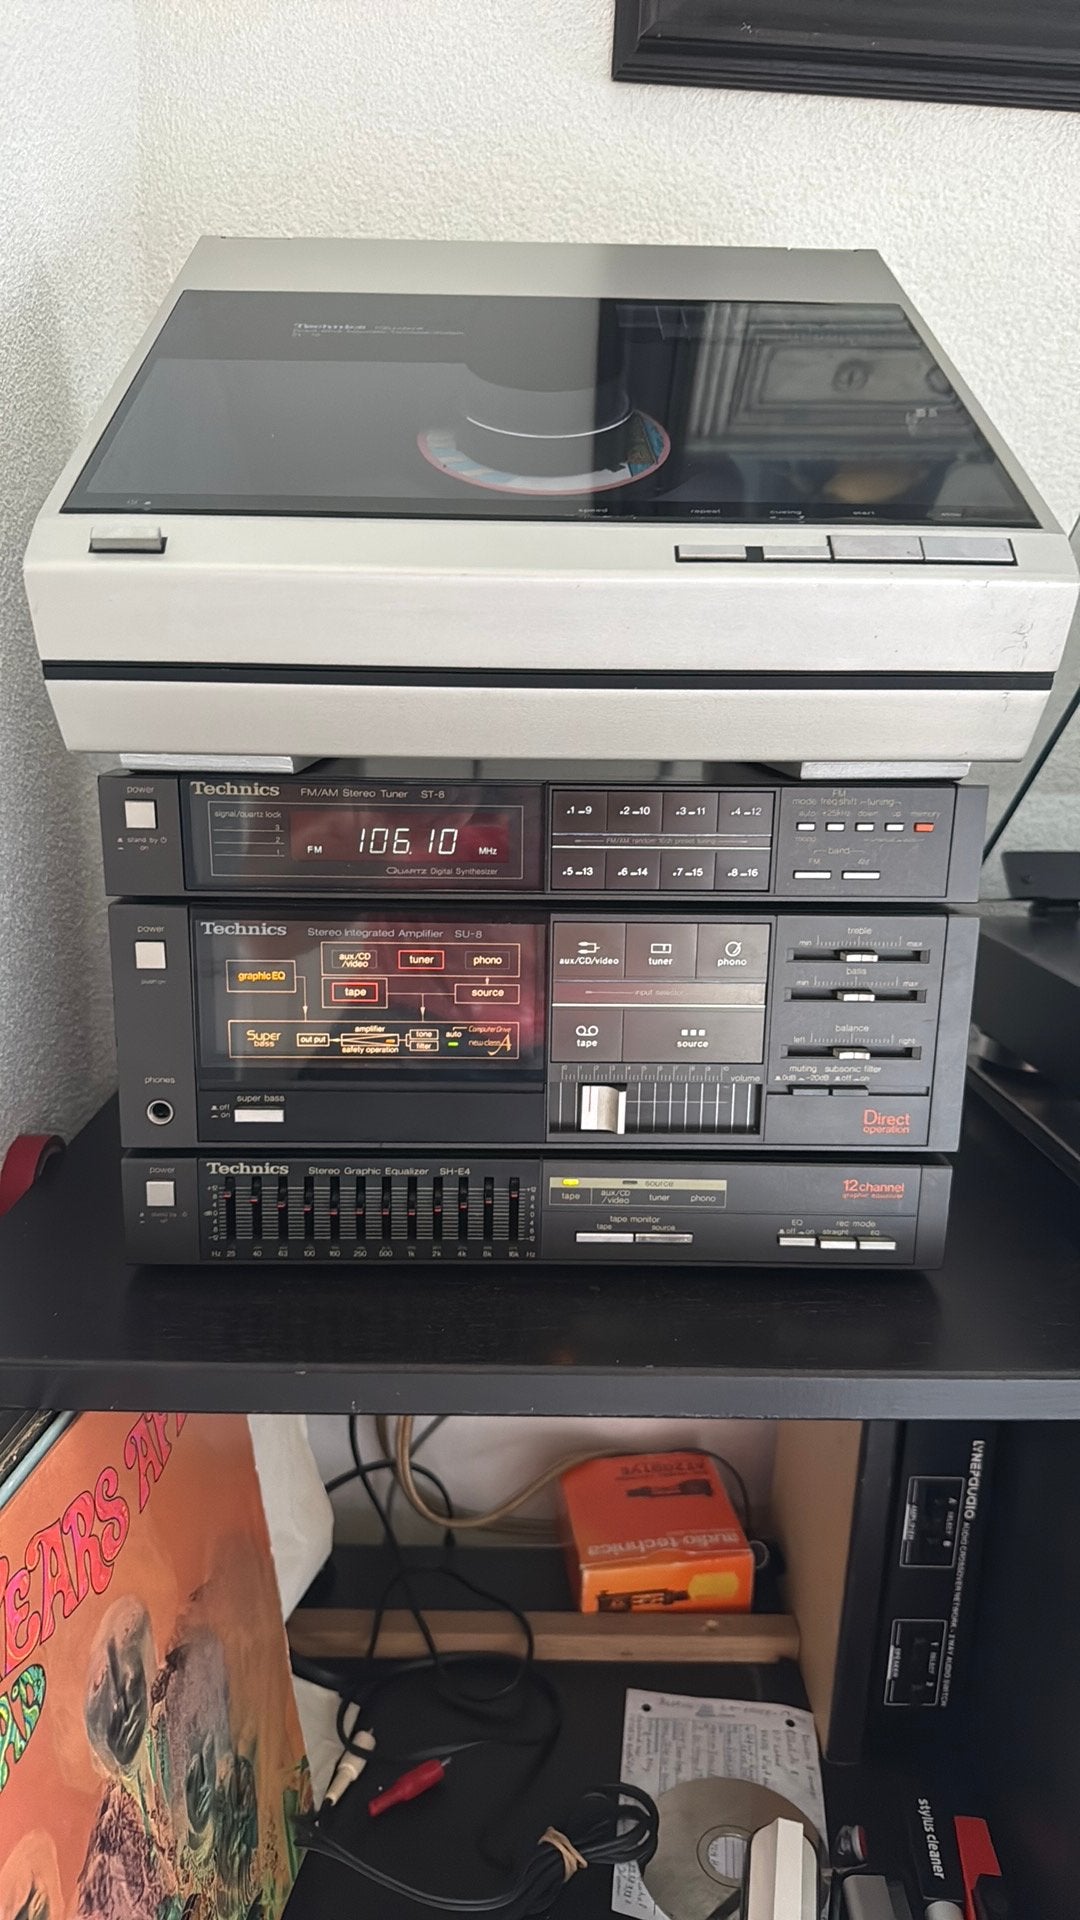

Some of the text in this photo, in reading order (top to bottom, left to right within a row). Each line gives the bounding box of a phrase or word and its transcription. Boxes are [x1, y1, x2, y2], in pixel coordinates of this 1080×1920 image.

[127, 786, 154, 794] power
[190, 781, 280, 796] Technics
[300, 787, 445, 799] FM/AM Stereo Tuner ST-8
[265, 810, 281, 818] lock
[307, 845, 323, 854] FM
[479, 847, 497, 856] MHz
[430, 867, 453, 876] Digital
[456, 867, 498, 876] Synthesizer
[137, 926, 165, 934] power
[201, 922, 287, 936] Technics
[307, 928, 483, 939] Stereo Integrated Amplifier SU-8
[848, 927, 872, 935] treble
[339, 952, 371, 961] aux/CD
[409, 955, 435, 965] tuner
[473, 955, 503, 966] phono
[341, 960, 369, 968] /video
[559, 957, 619, 966] aux/CD/video
[648, 957, 673, 966] tuner
[717, 958, 748, 967] phono
[846, 967, 867, 975] bass
[344, 987, 367, 998] tape
[471, 988, 505, 998] source
[355, 1025, 386, 1034] amplifier
[835, 1024, 869, 1032] balance
[246, 1029, 282, 1042] Super
[576, 1038, 598, 1048] tape
[677, 1039, 709, 1048] source
[899, 1037, 916, 1046] right
[342, 1046, 399, 1055] safety operation
[789, 1065, 817, 1074] muting
[824, 1065, 882, 1073] subsonic filter
[144, 1076, 175, 1085] phones
[236, 1094, 285, 1103] super bass
[863, 1109, 911, 1126] Direct
[863, 1125, 910, 1135] operation
[150, 1166, 175, 1175] power
[206, 1162, 289, 1175] Technics
[308, 1166, 471, 1176] Stereo Graphic Equalizer SH-E4
[645, 1180, 674, 1188] source
[859, 1182, 905, 1192] channel
[561, 1193, 580, 1202] tape
[601, 1196, 630, 1204] /video
[649, 1194, 670, 1202] tuner
[690, 1195, 716, 1203] phono
[610, 1215, 627, 1224] tape
[597, 1223, 612, 1231] tape
[0, 1466, 130, 1681] EARS
[918, 1798, 945, 1879] stylus cleaner
